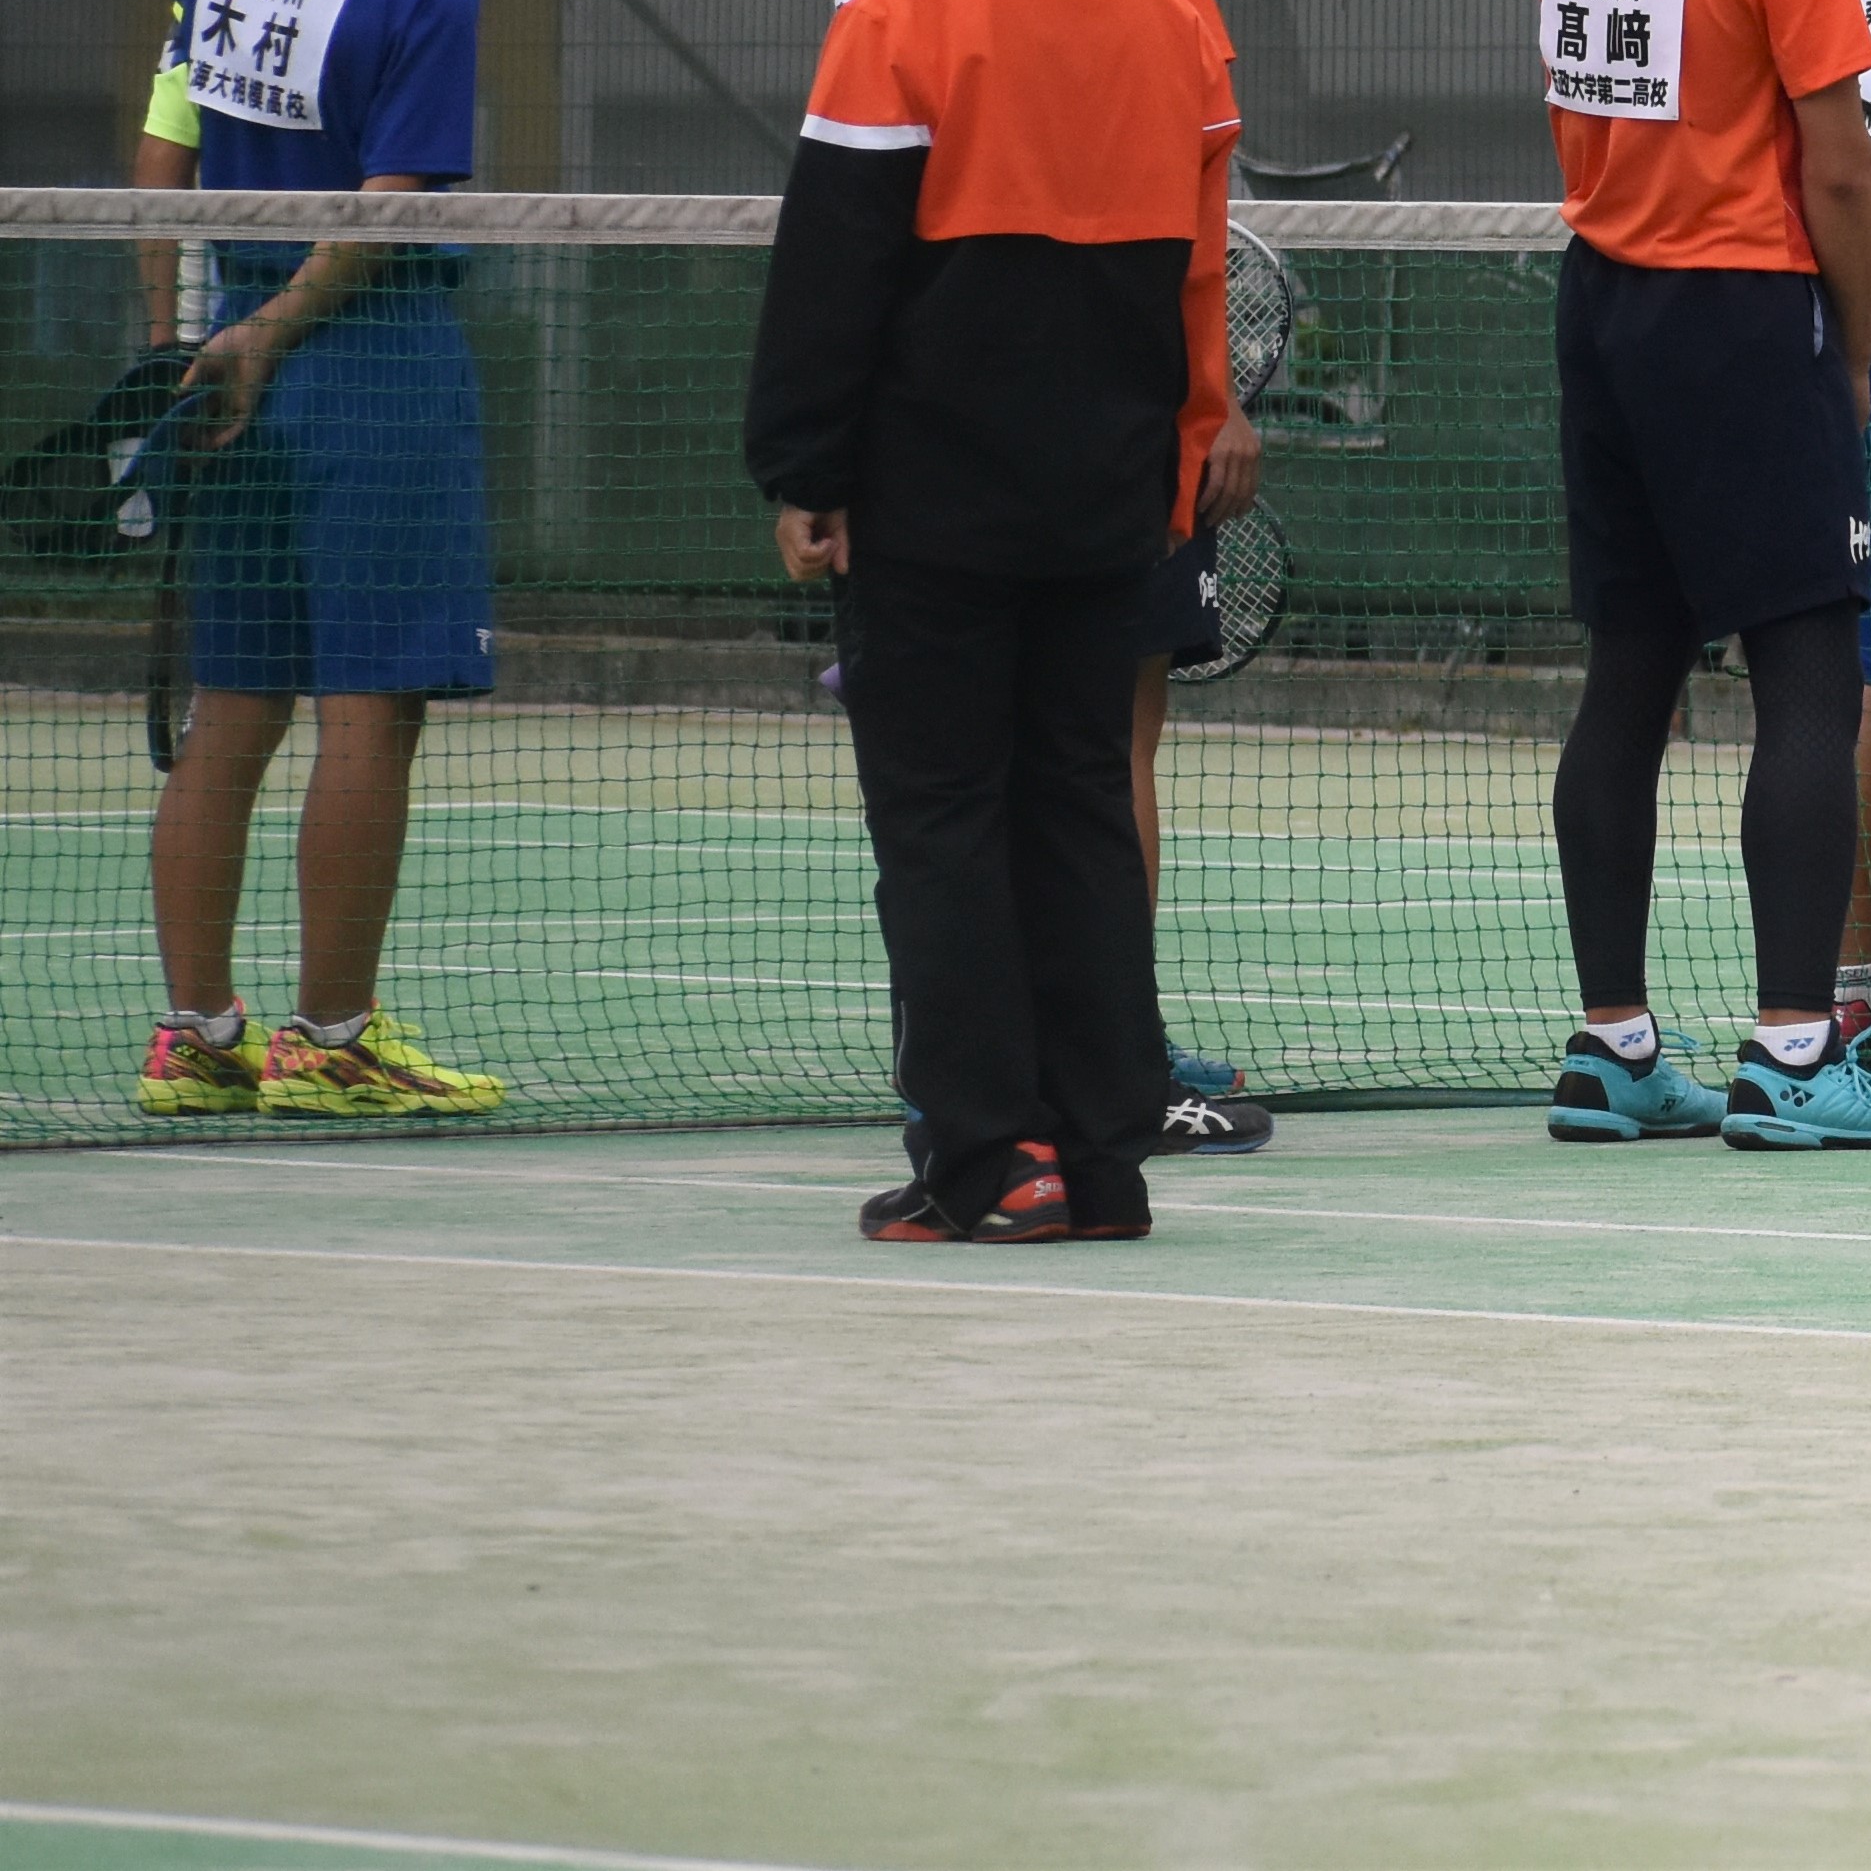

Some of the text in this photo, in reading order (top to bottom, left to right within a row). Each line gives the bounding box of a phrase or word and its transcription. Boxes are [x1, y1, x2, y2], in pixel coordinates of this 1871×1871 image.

[189, 58, 309, 120] 海大相模高校
